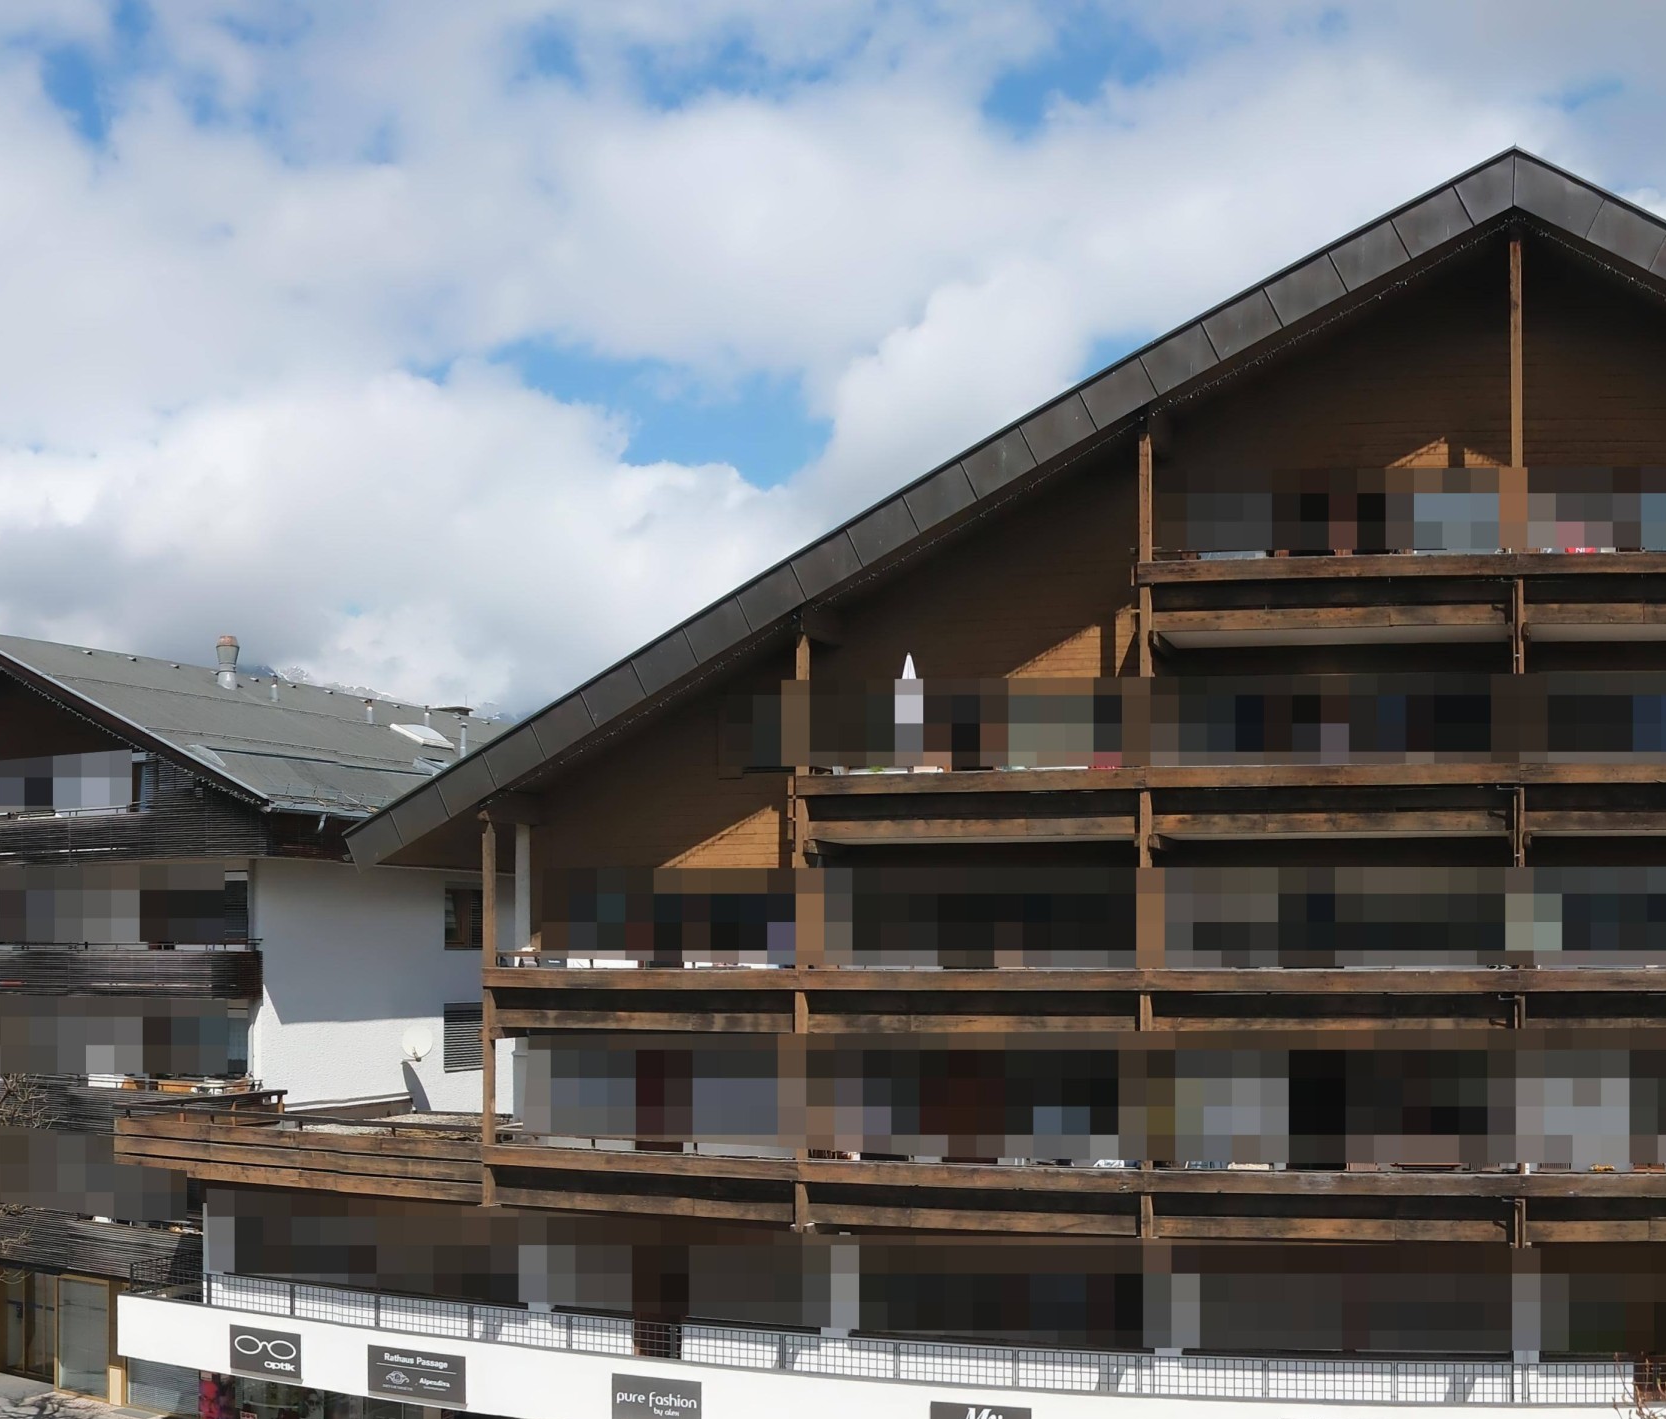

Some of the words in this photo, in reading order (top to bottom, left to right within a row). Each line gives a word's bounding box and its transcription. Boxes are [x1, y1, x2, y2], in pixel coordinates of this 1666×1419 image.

[264, 1361, 296, 1372] optik
[384, 1352, 415, 1365] Rathaus
[416, 1356, 449, 1370] Passage
[616, 1392, 646, 1404] pure
[649, 1391, 698, 1409] fashion
